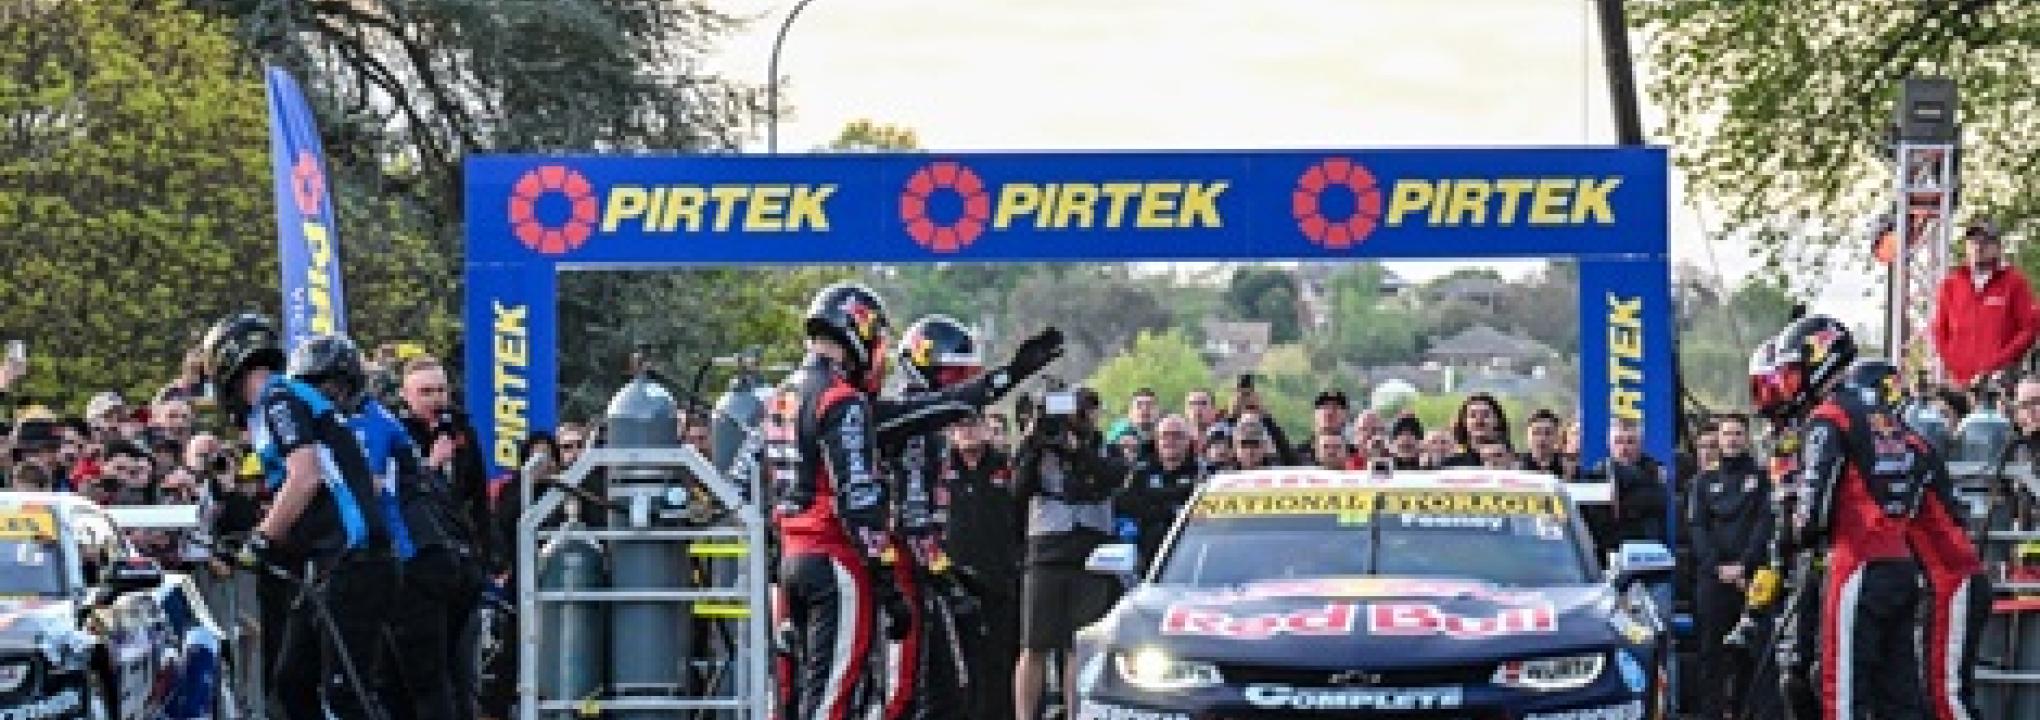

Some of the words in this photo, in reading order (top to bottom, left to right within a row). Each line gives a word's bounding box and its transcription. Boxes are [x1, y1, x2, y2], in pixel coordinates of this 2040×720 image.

[602, 184, 836, 232] PIRTEK
[994, 180, 1231, 229] PIRTEK
[1386, 176, 1622, 227] PIRTEK
[303, 222, 333, 336] PIR
[1606, 292, 1643, 419] RTEK
[1191, 493, 1367, 516] NATIONAL
[1159, 600, 1355, 640] Red
[1367, 602, 1558, 640] Bull
